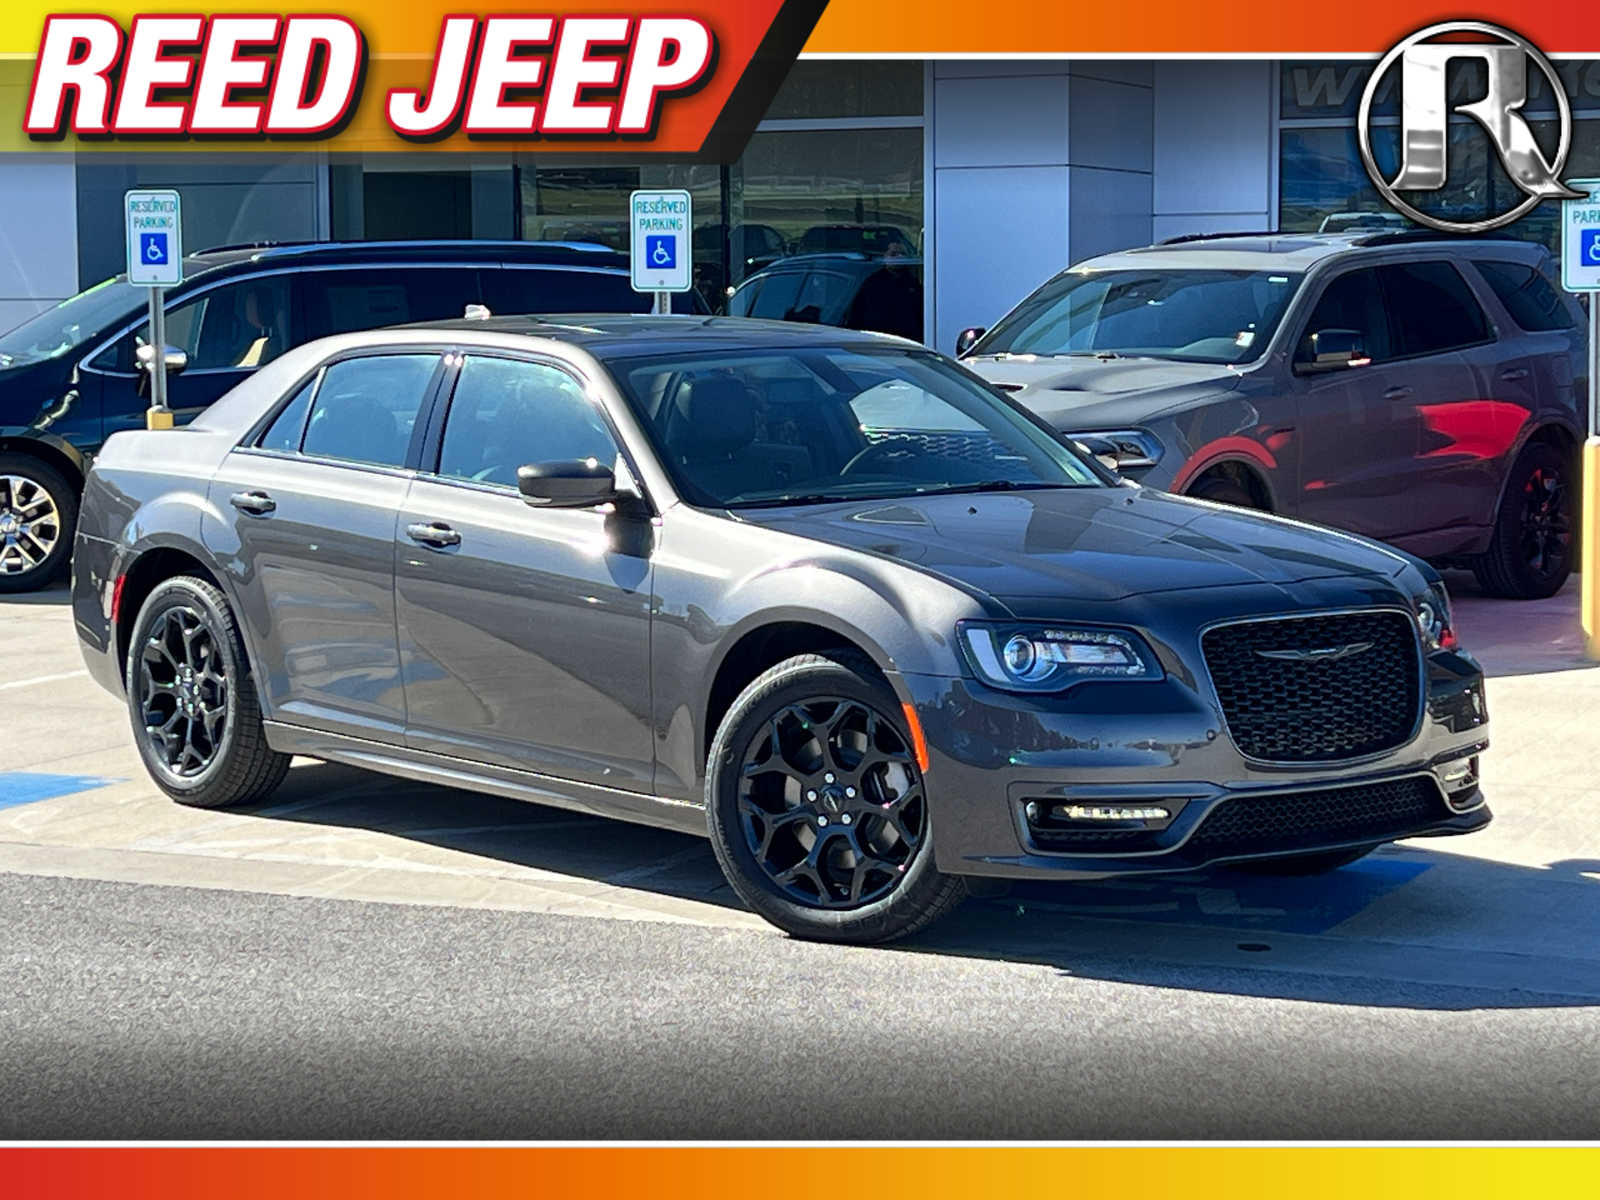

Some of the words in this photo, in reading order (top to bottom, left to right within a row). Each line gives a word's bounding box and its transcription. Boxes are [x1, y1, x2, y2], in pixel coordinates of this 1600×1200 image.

[130, 200, 177, 212] RESERVED
[635, 200, 686, 213] RESERVED
[133, 216, 173, 229] PARKING
[639, 218, 683, 231] PARKING
